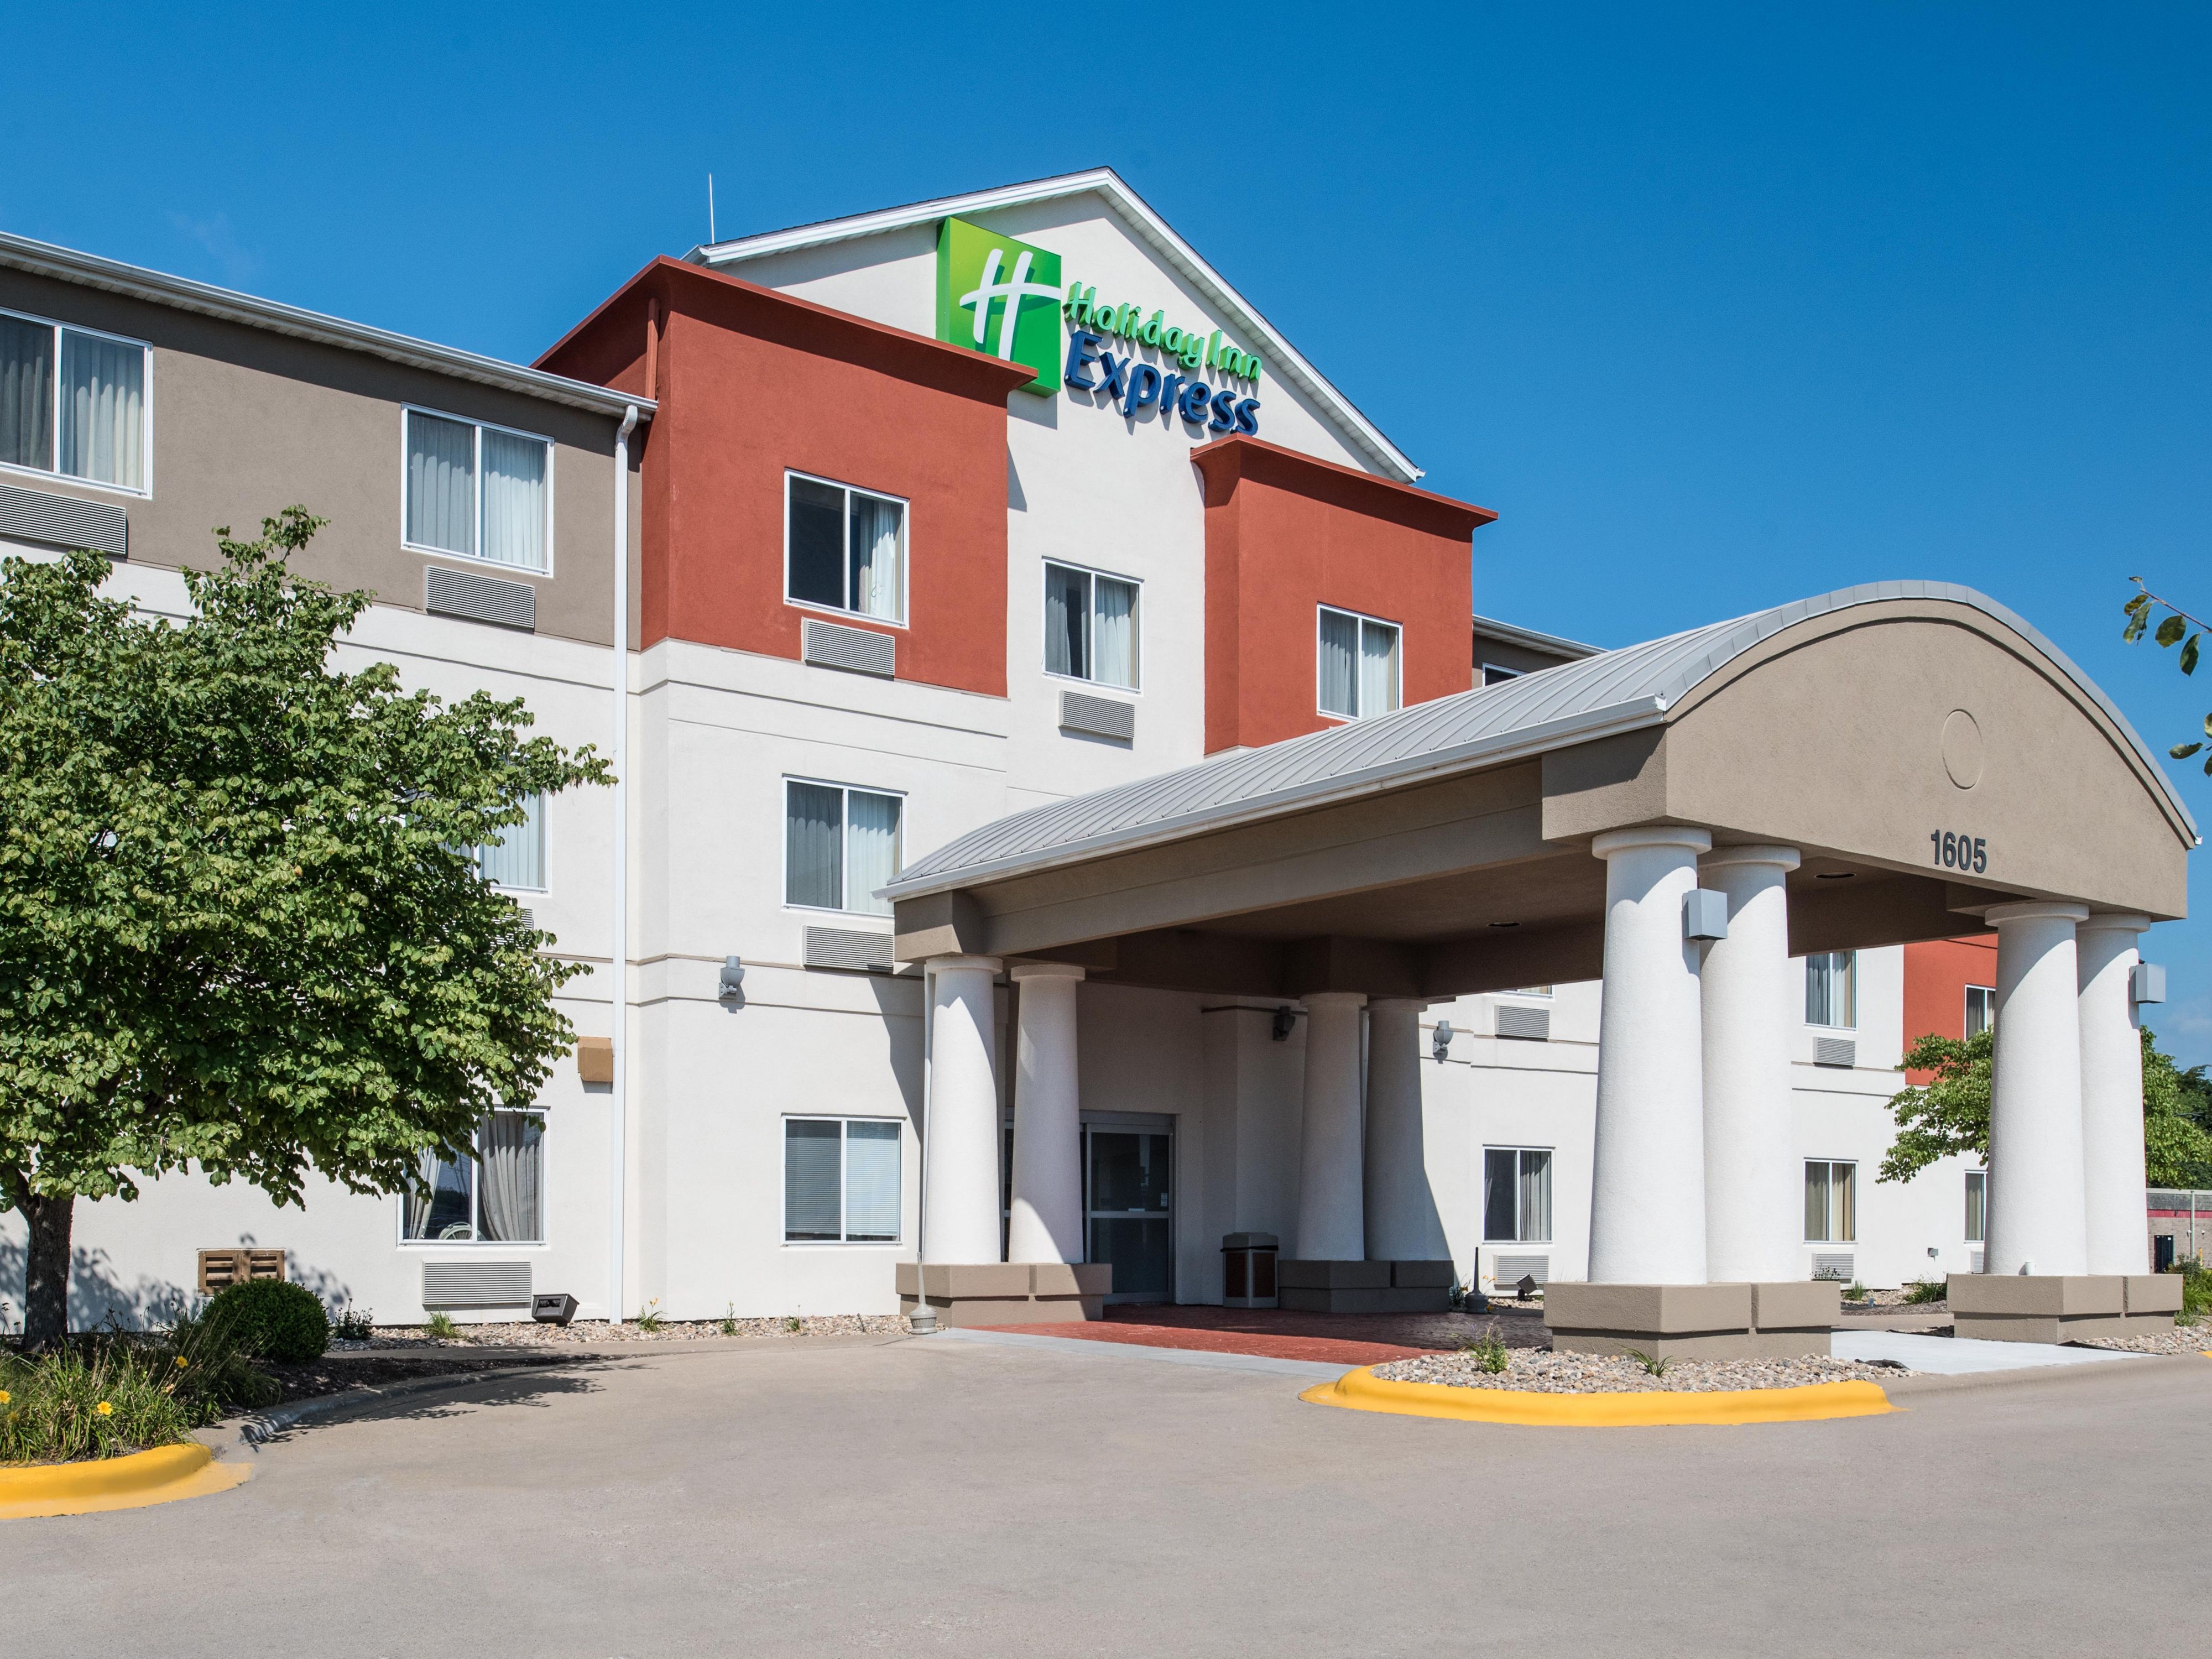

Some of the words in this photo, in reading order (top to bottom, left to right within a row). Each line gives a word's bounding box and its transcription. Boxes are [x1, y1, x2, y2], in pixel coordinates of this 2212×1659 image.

[1062, 281, 1205, 371] Holiday
[1205, 330, 1262, 383] Inn
[1064, 330, 1261, 436] Express
[1931, 830, 1986, 873] 1605
